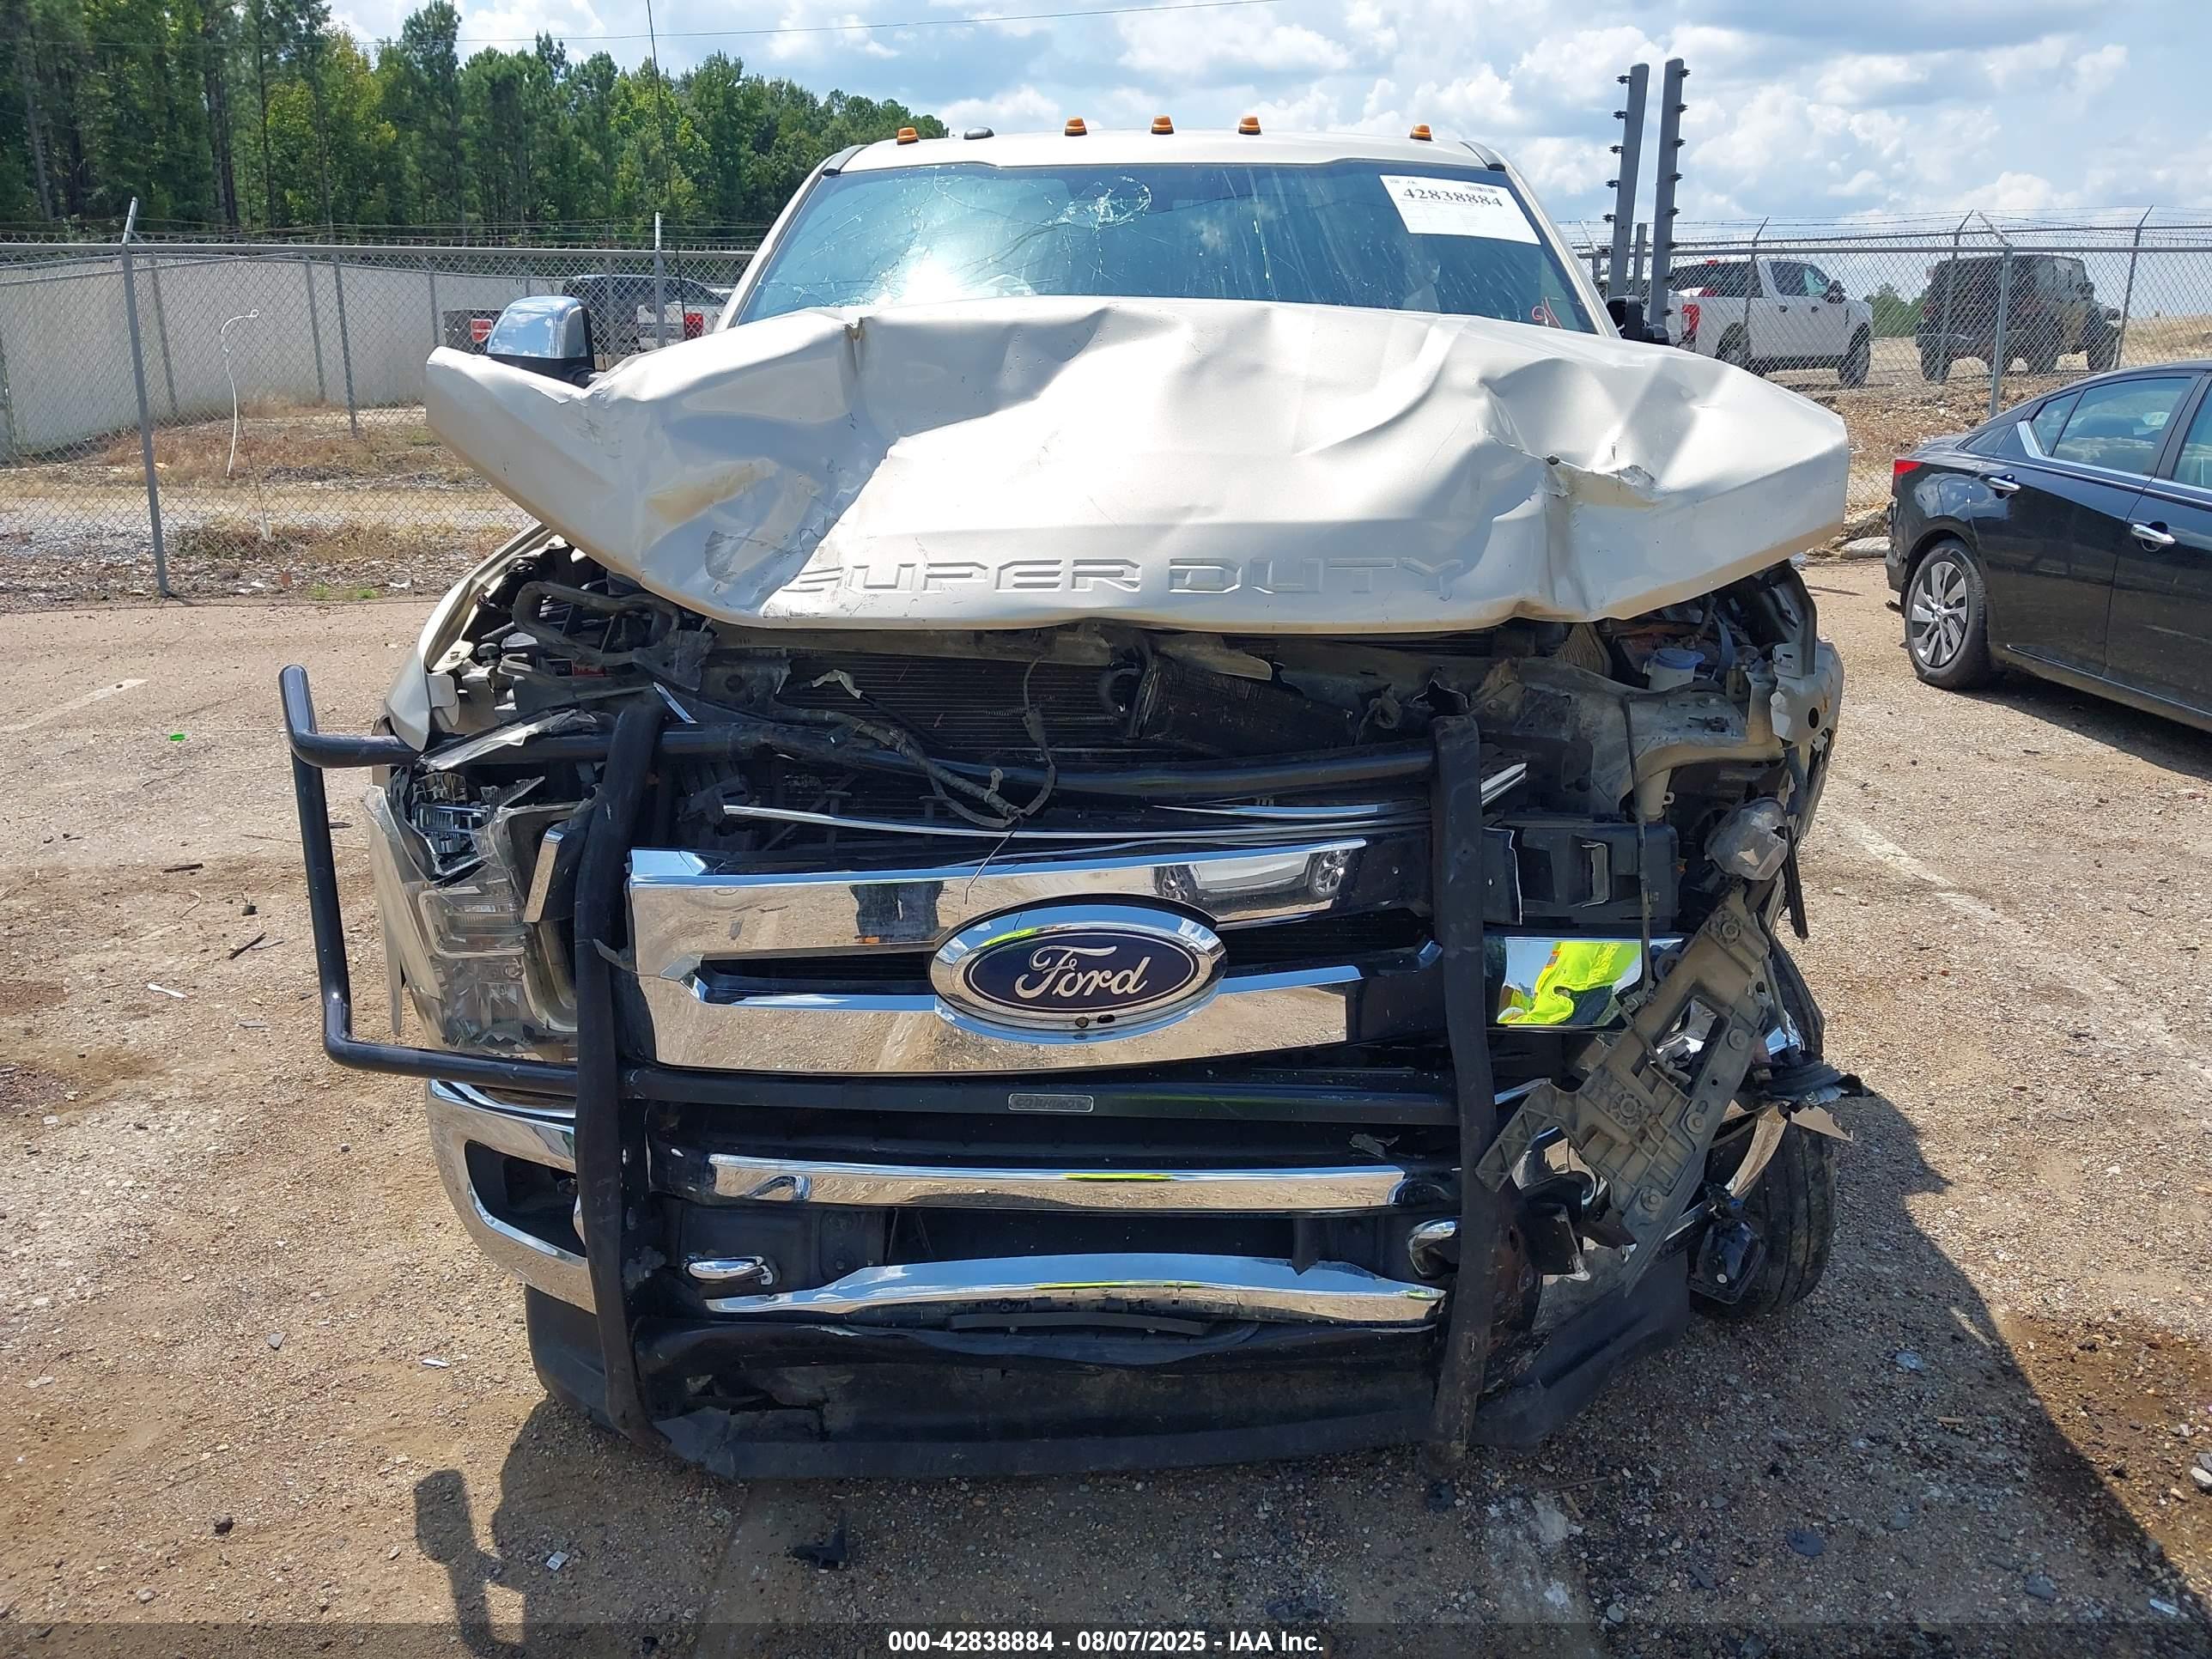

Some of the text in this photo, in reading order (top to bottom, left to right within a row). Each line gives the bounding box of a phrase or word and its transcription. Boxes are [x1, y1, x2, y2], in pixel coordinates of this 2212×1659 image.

[1403, 187, 1504, 208] 42838884
[780, 556, 1464, 595] SUPER DUTY
[1014, 945, 1152, 1000] Ford
